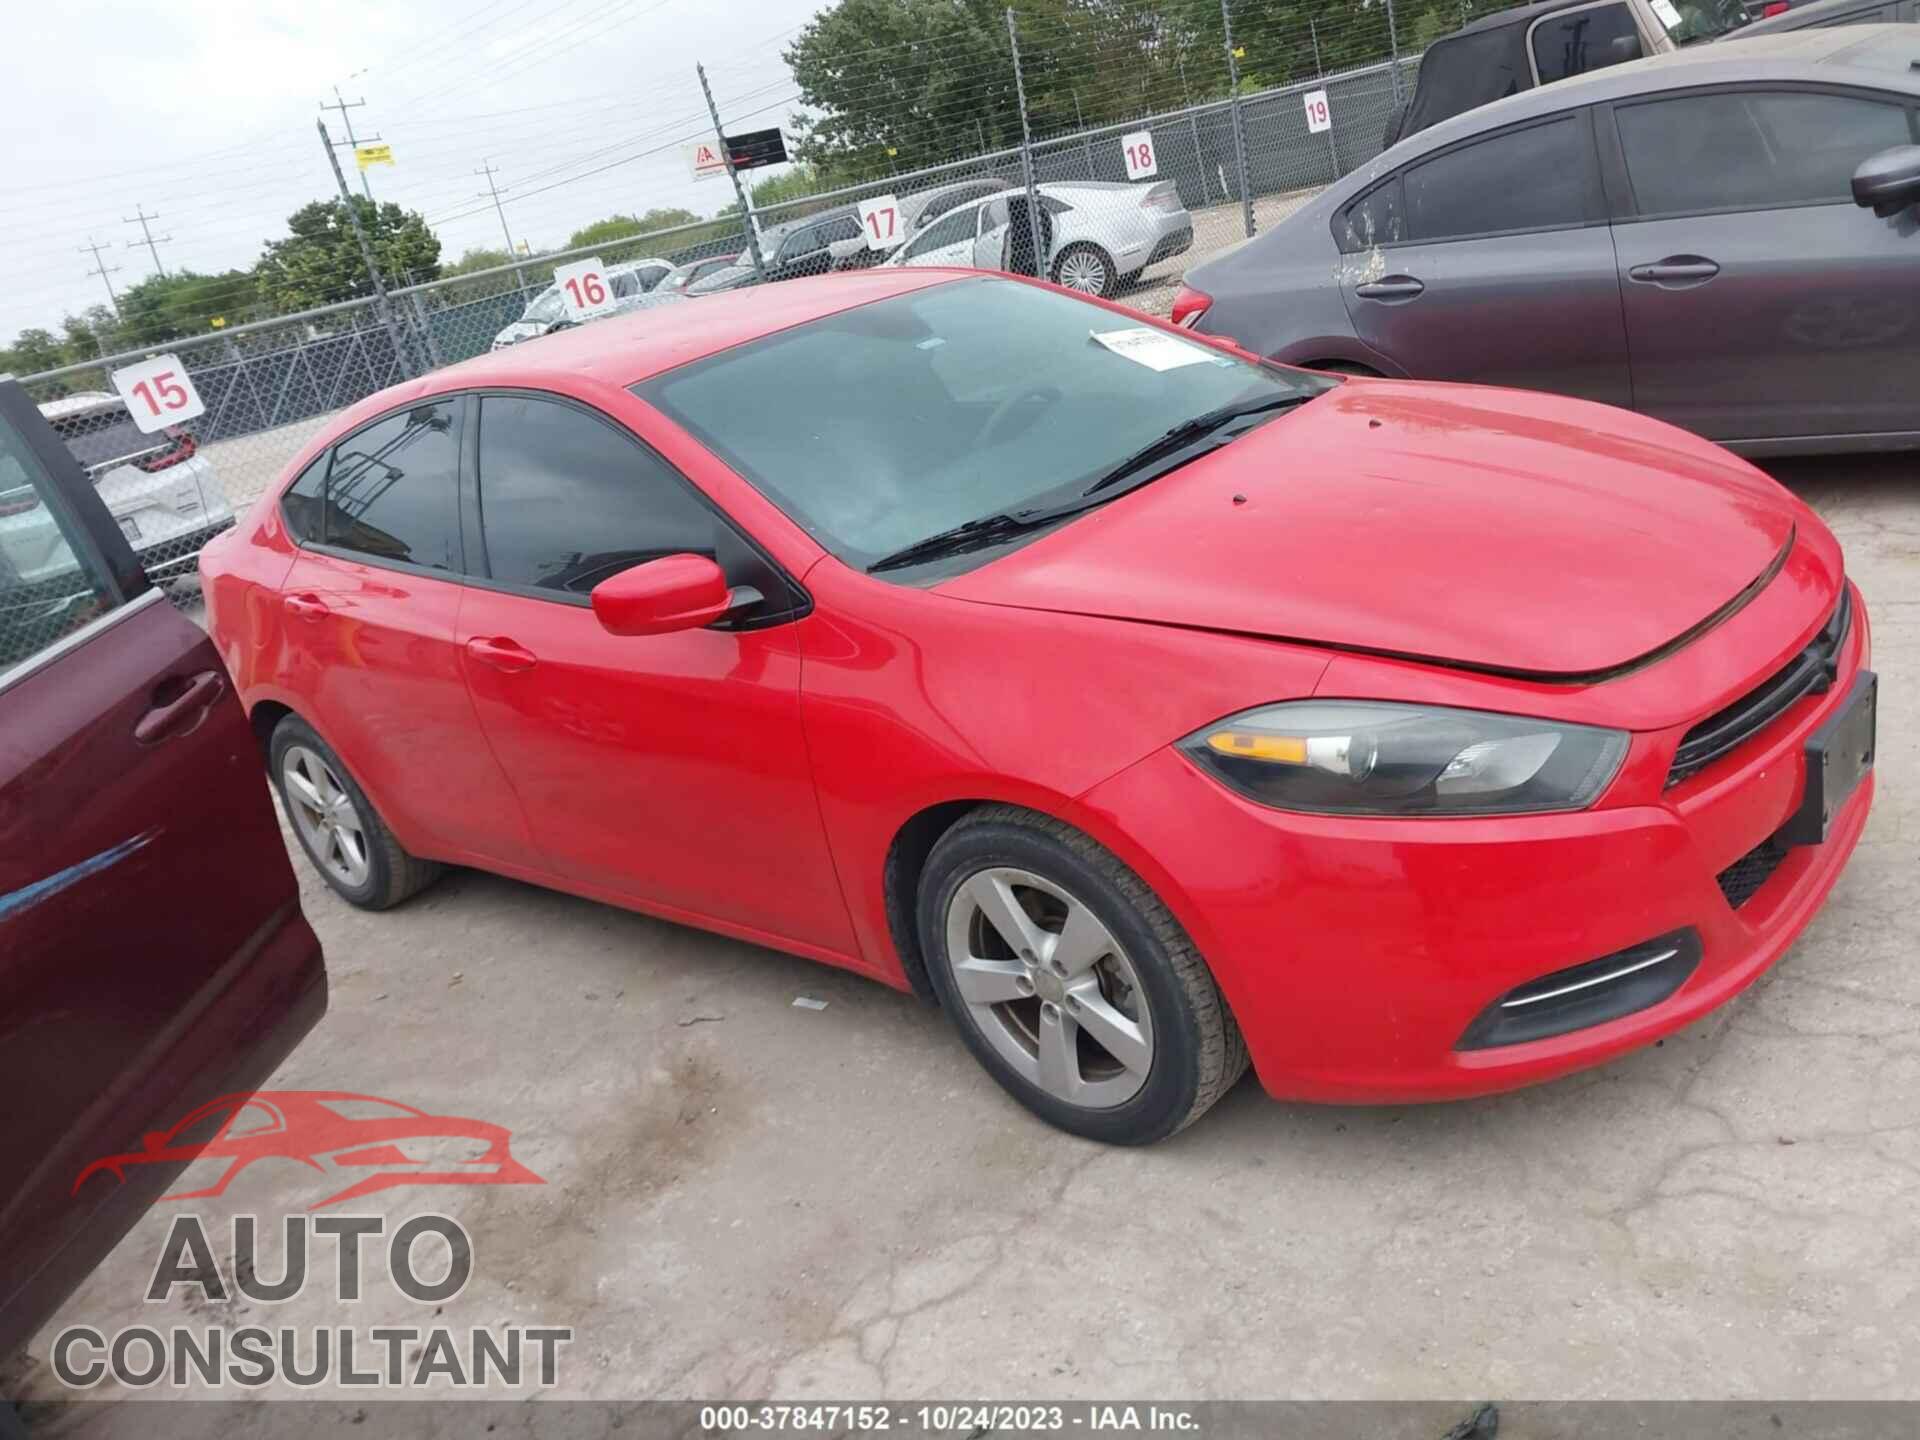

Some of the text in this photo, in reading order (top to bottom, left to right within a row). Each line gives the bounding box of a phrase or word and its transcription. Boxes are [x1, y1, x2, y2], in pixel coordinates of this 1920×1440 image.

[1308, 102, 1327, 123] 19
[1126, 143, 1153, 171] 18
[867, 207, 895, 239] 17
[565, 272, 606, 307] 16
[132, 371, 189, 415] 15
